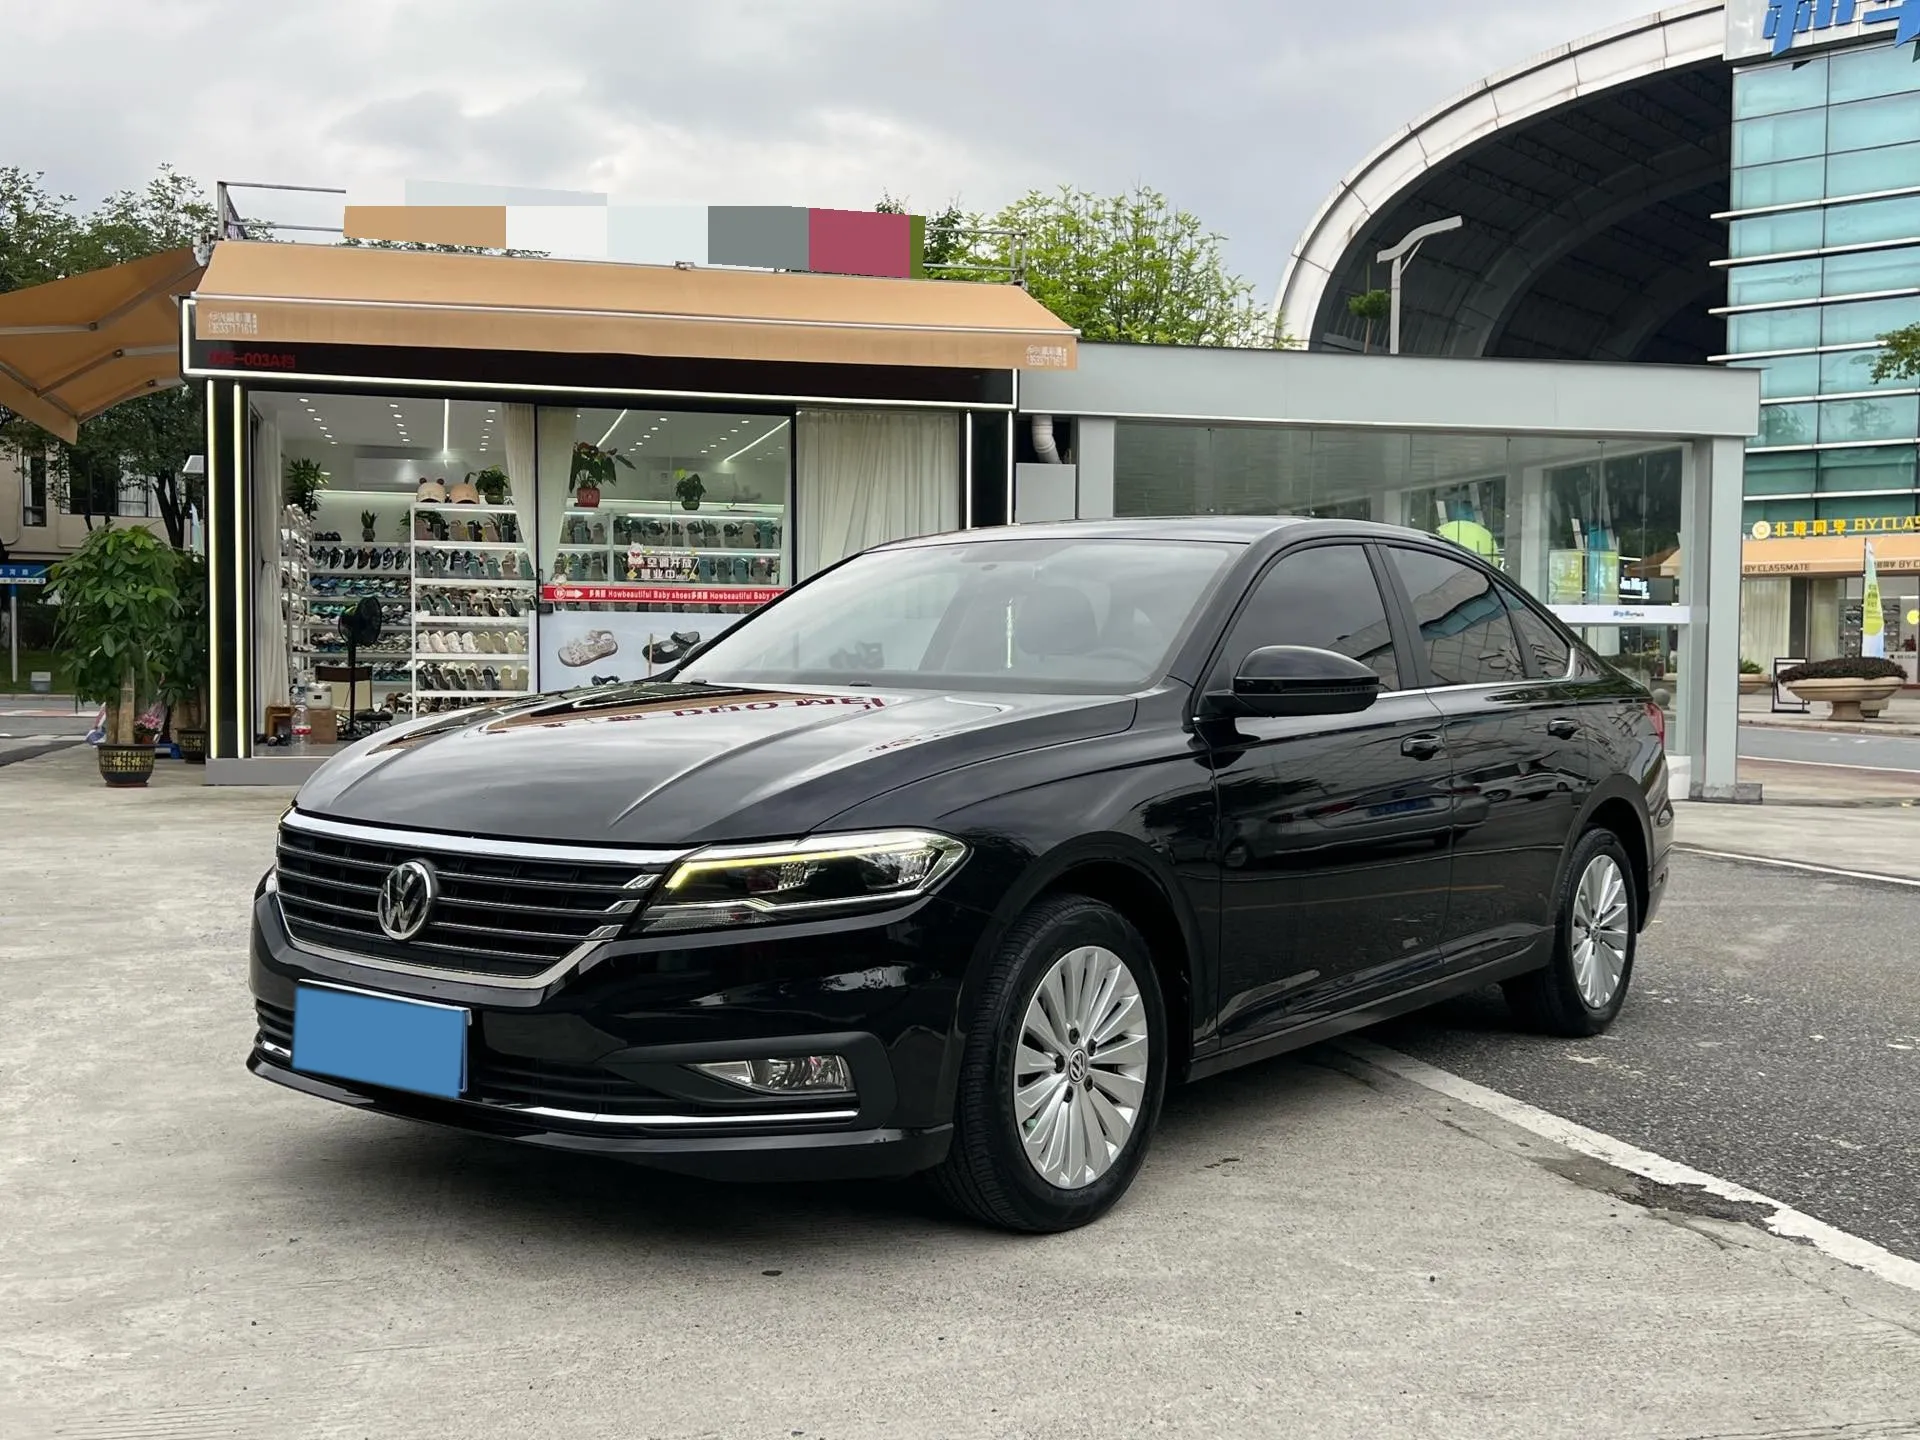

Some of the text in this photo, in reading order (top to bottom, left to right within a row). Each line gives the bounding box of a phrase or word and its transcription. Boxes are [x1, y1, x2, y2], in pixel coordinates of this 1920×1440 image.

[1854, 518, 1878, 531] BY
[1744, 563, 1810, 573] BY CLASSMATE
[608, 590, 652, 599] Howbeautiful
[653, 590, 671, 600] Baby
[672, 591, 691, 600] shoes
[710, 592, 751, 600] Howbeautiful
[753, 592, 770, 601] Baby
